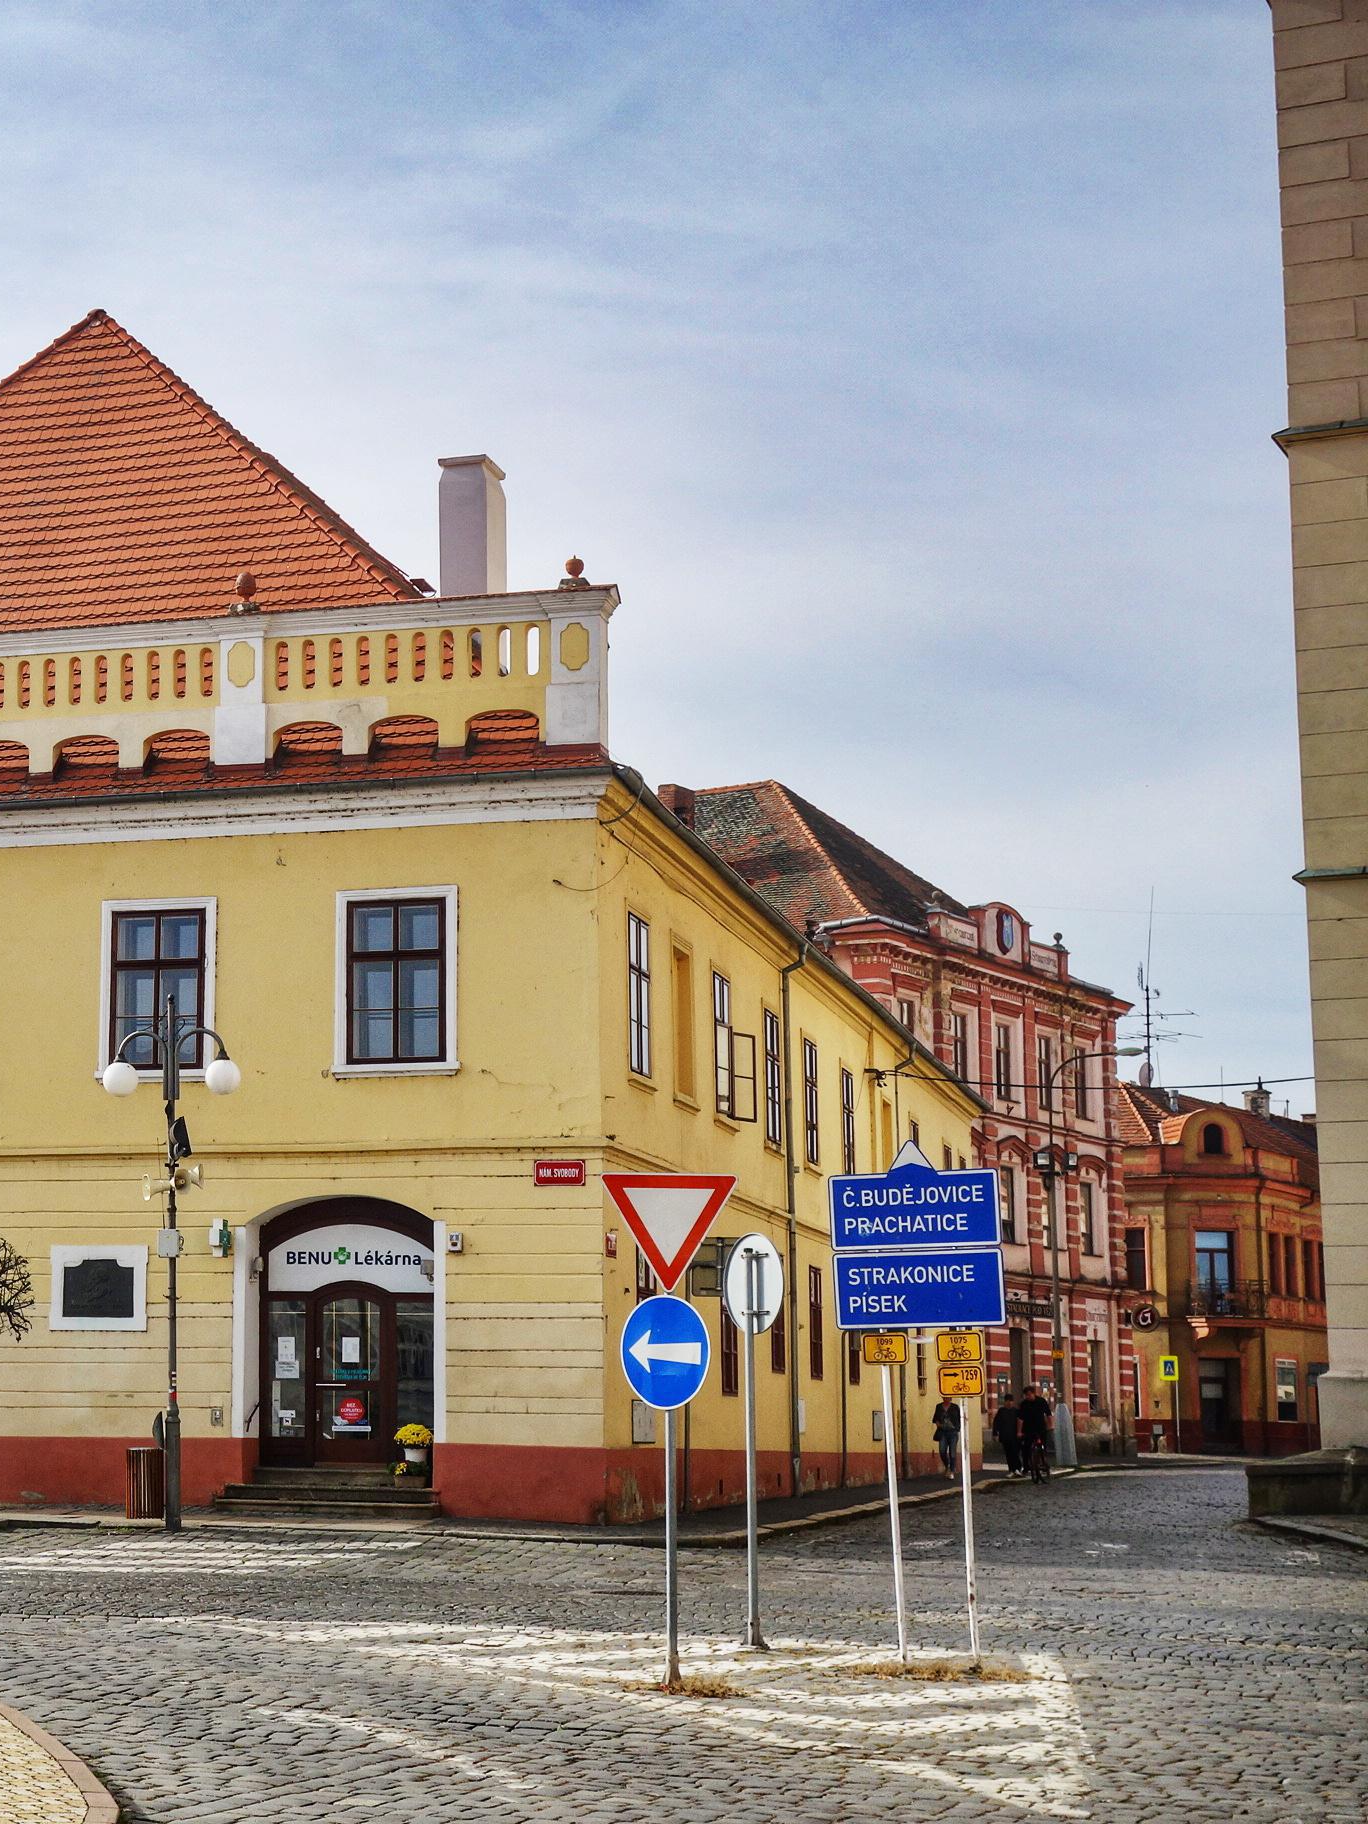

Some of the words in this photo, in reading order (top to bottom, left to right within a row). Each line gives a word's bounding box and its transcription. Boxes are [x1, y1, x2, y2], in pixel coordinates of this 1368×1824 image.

[553, 1168, 579, 1178] SVOBODY
[844, 1213, 969, 1236] PRACHATICE
[286, 1251, 332, 1265] BENU
[354, 1250, 421, 1266] Lékárna
[848, 1265, 975, 1286] STRAKONICE
[849, 1291, 908, 1313] PÍSEK
[876, 1338, 893, 1346] 1099
[949, 1336, 968, 1344] 1075
[961, 1369, 978, 1380] 1259
